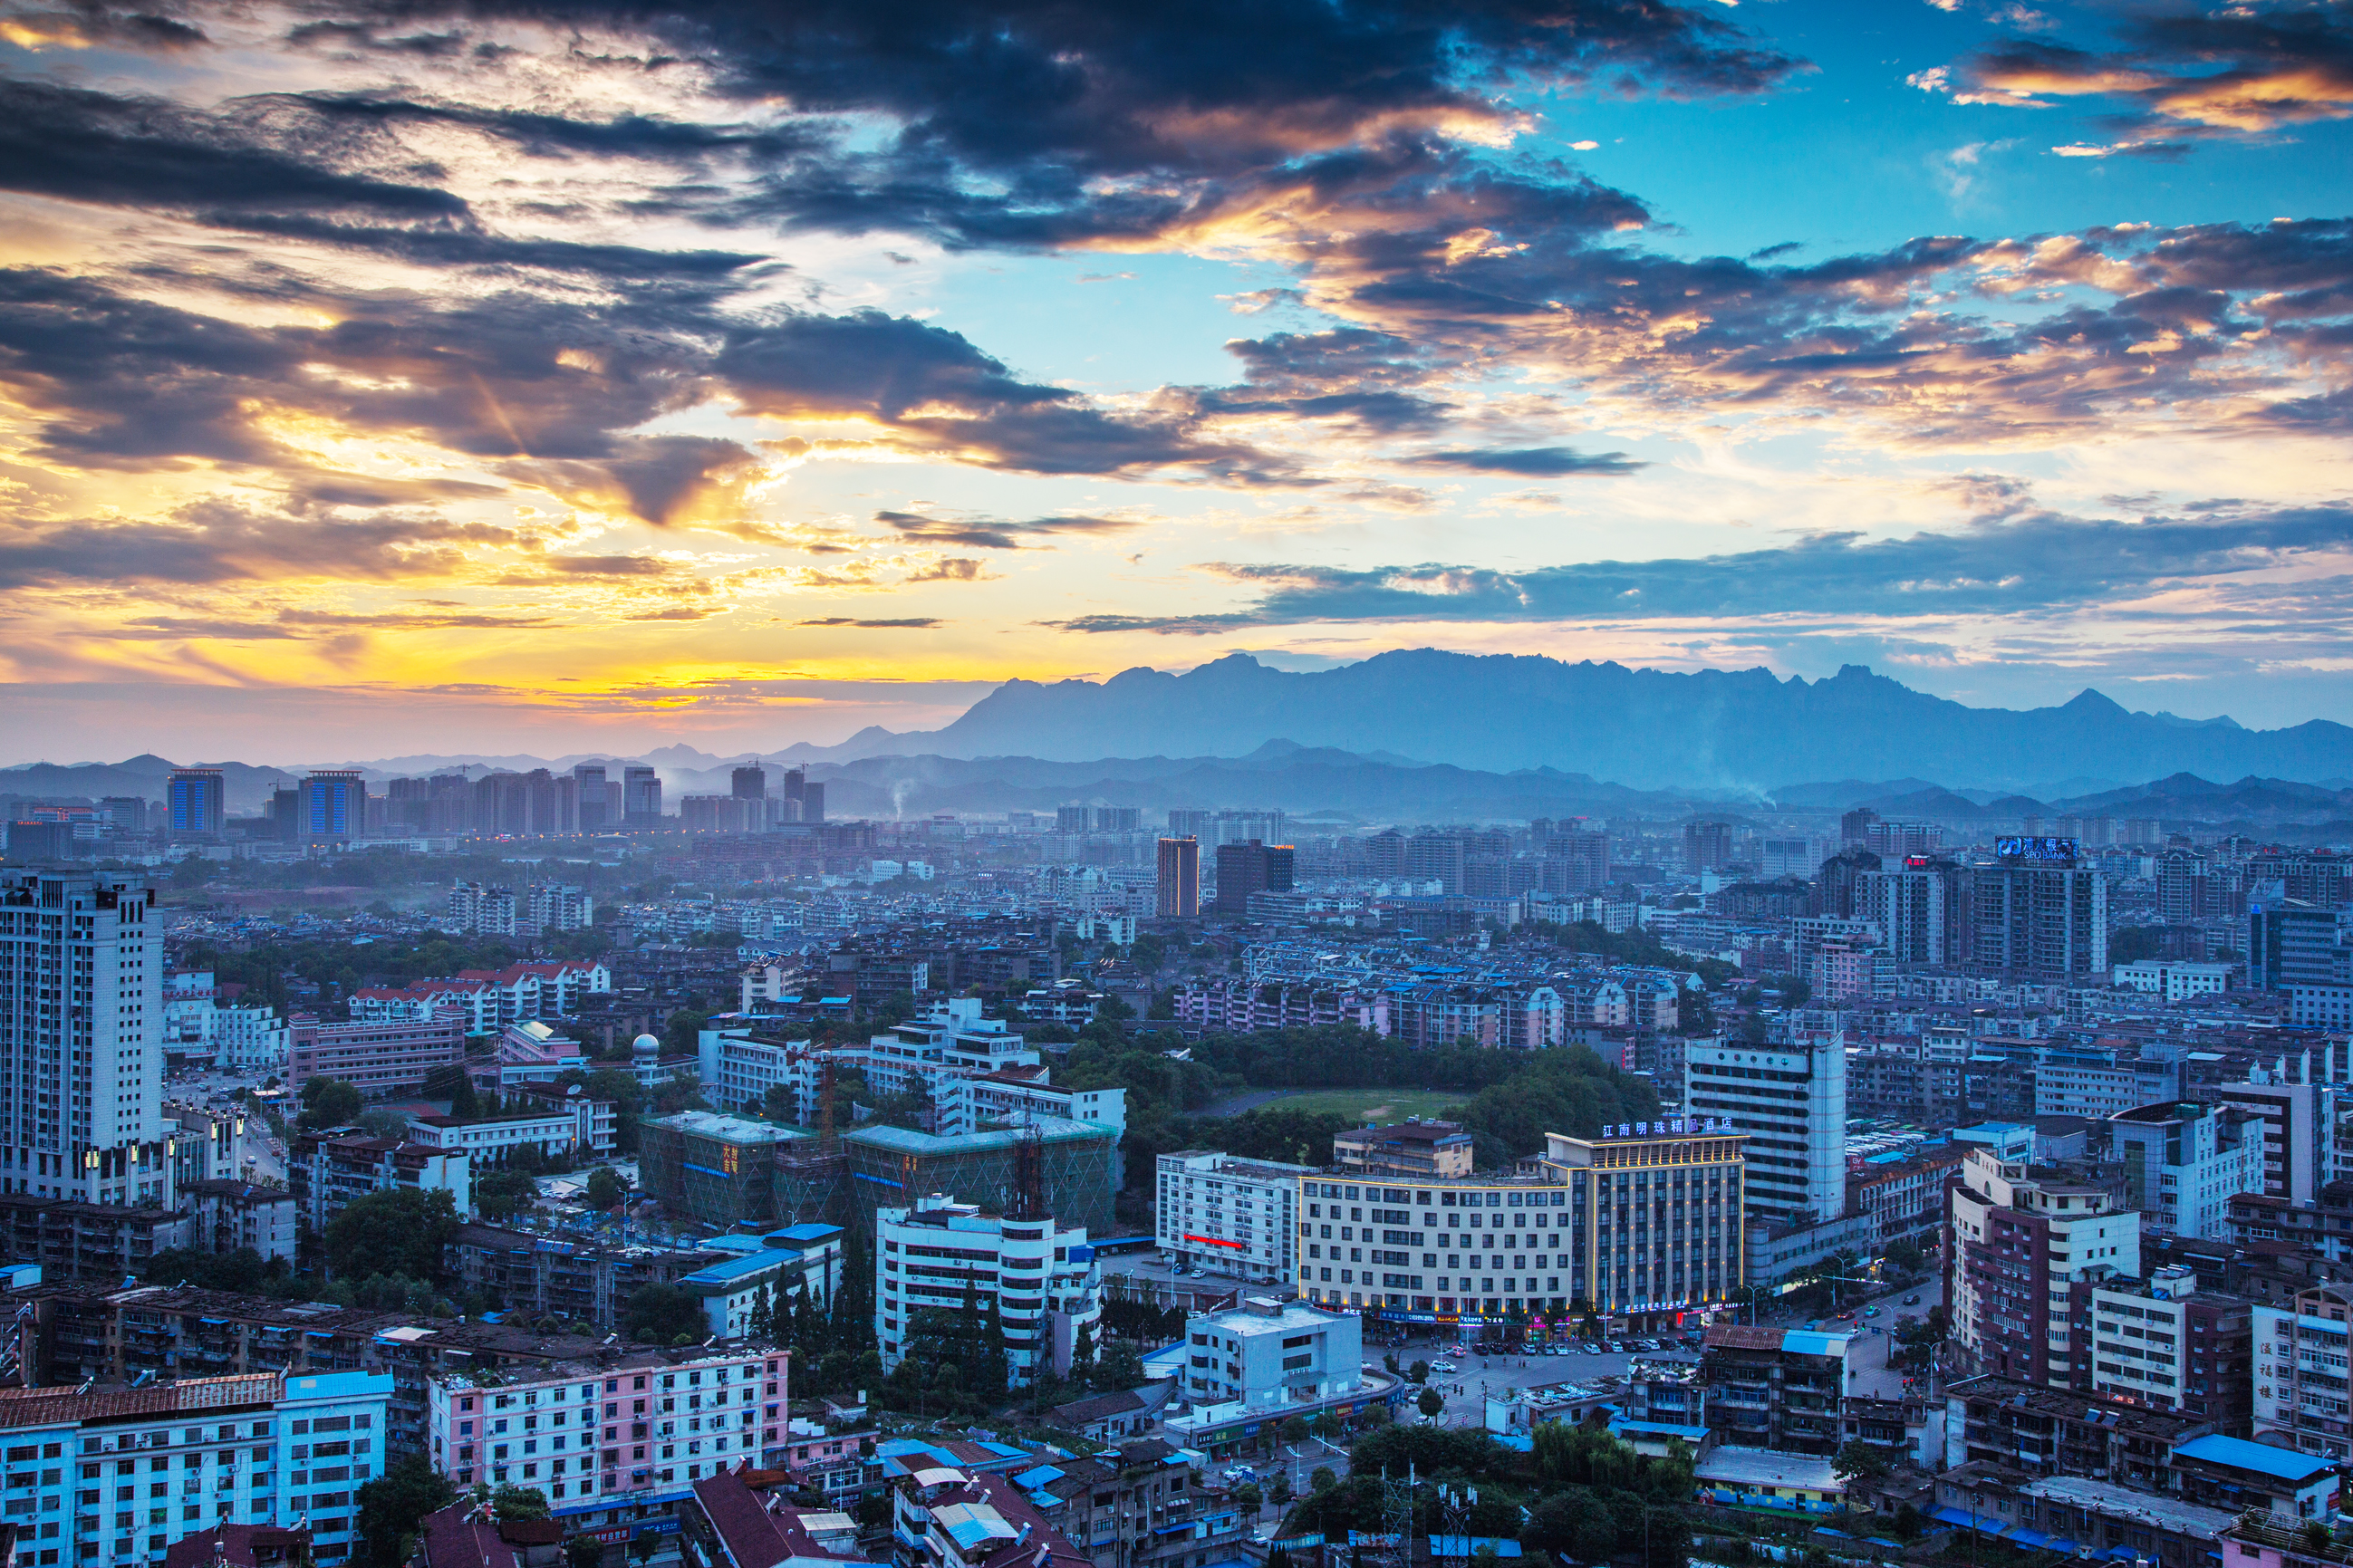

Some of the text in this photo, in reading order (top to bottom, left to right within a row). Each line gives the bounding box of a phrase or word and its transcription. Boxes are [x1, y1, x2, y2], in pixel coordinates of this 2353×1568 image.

[2024, 851, 2067, 860] SPD BANK
[1603, 1117, 1732, 1138] 江南明珠精品酒店
[723, 1145, 730, 1173] 大吉
